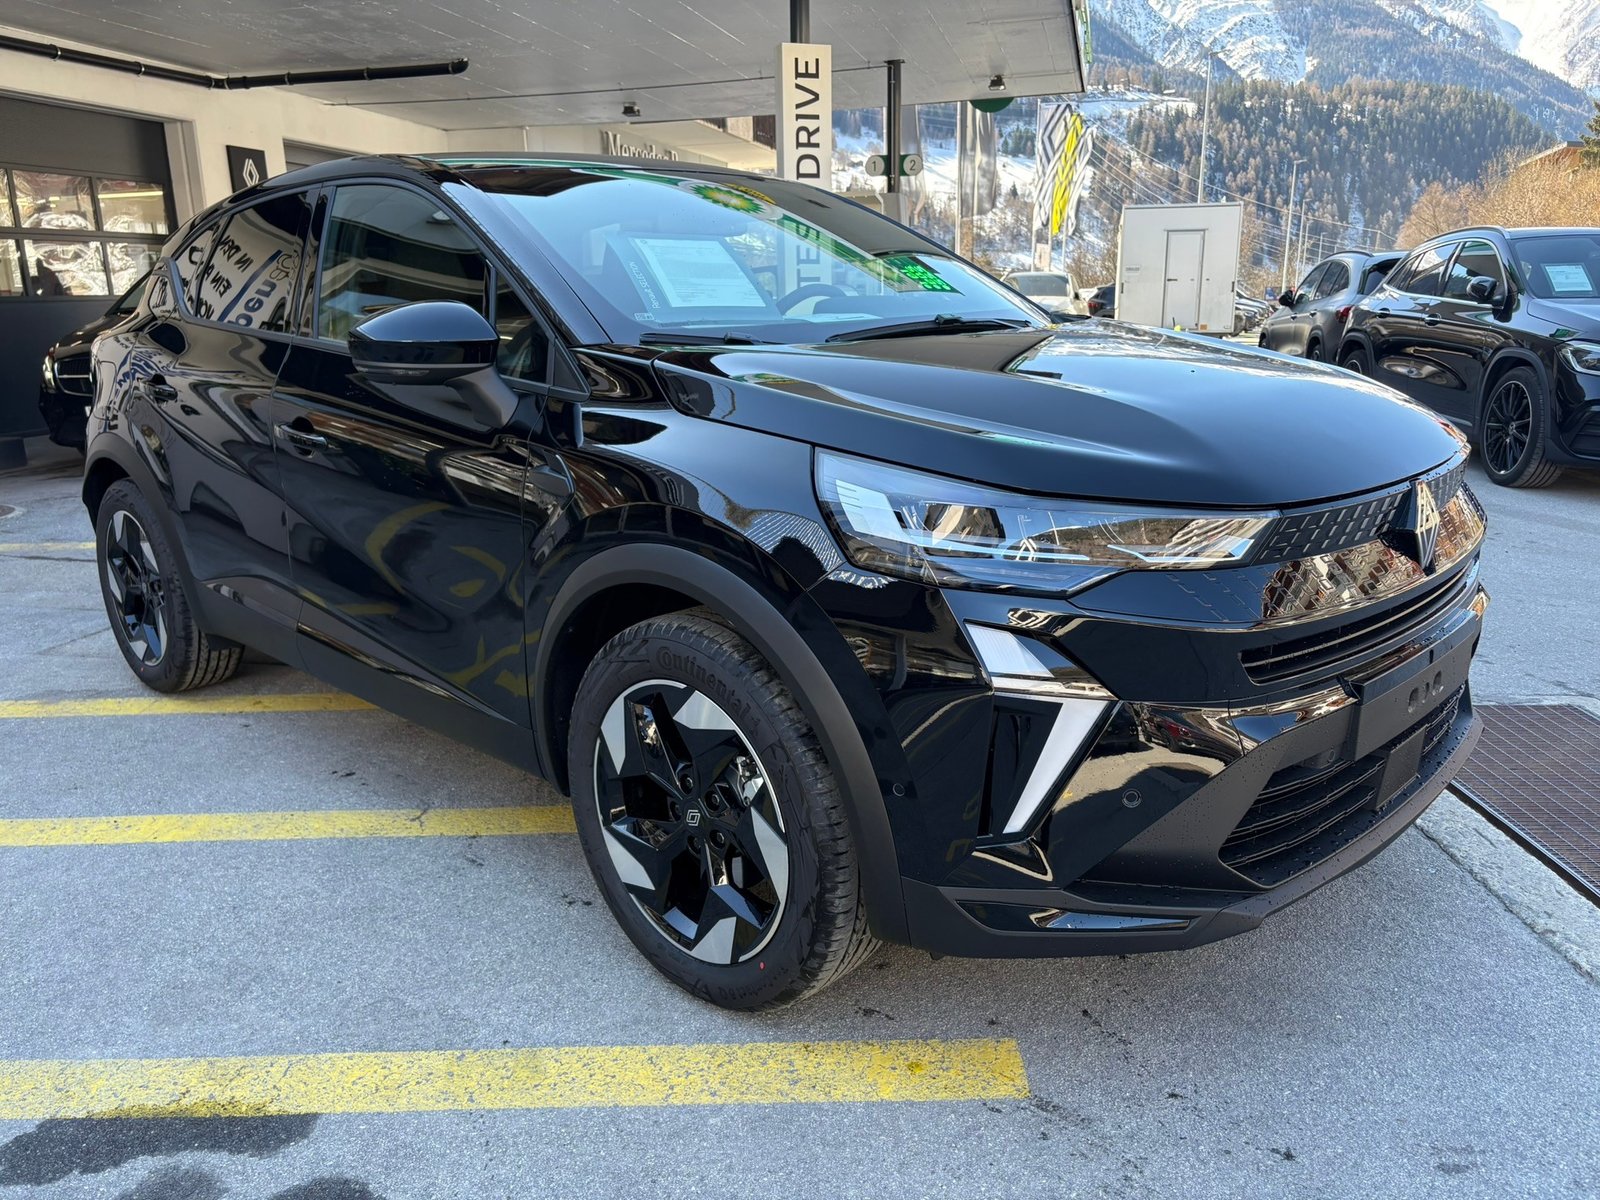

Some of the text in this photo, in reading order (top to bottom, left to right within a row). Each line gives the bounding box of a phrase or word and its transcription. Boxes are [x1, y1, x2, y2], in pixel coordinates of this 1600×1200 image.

[794, 57, 820, 180] DRIVE
[871, 160, 877, 172] 1
[909, 159, 916, 171] 2
[656, 646, 752, 719] Continental
